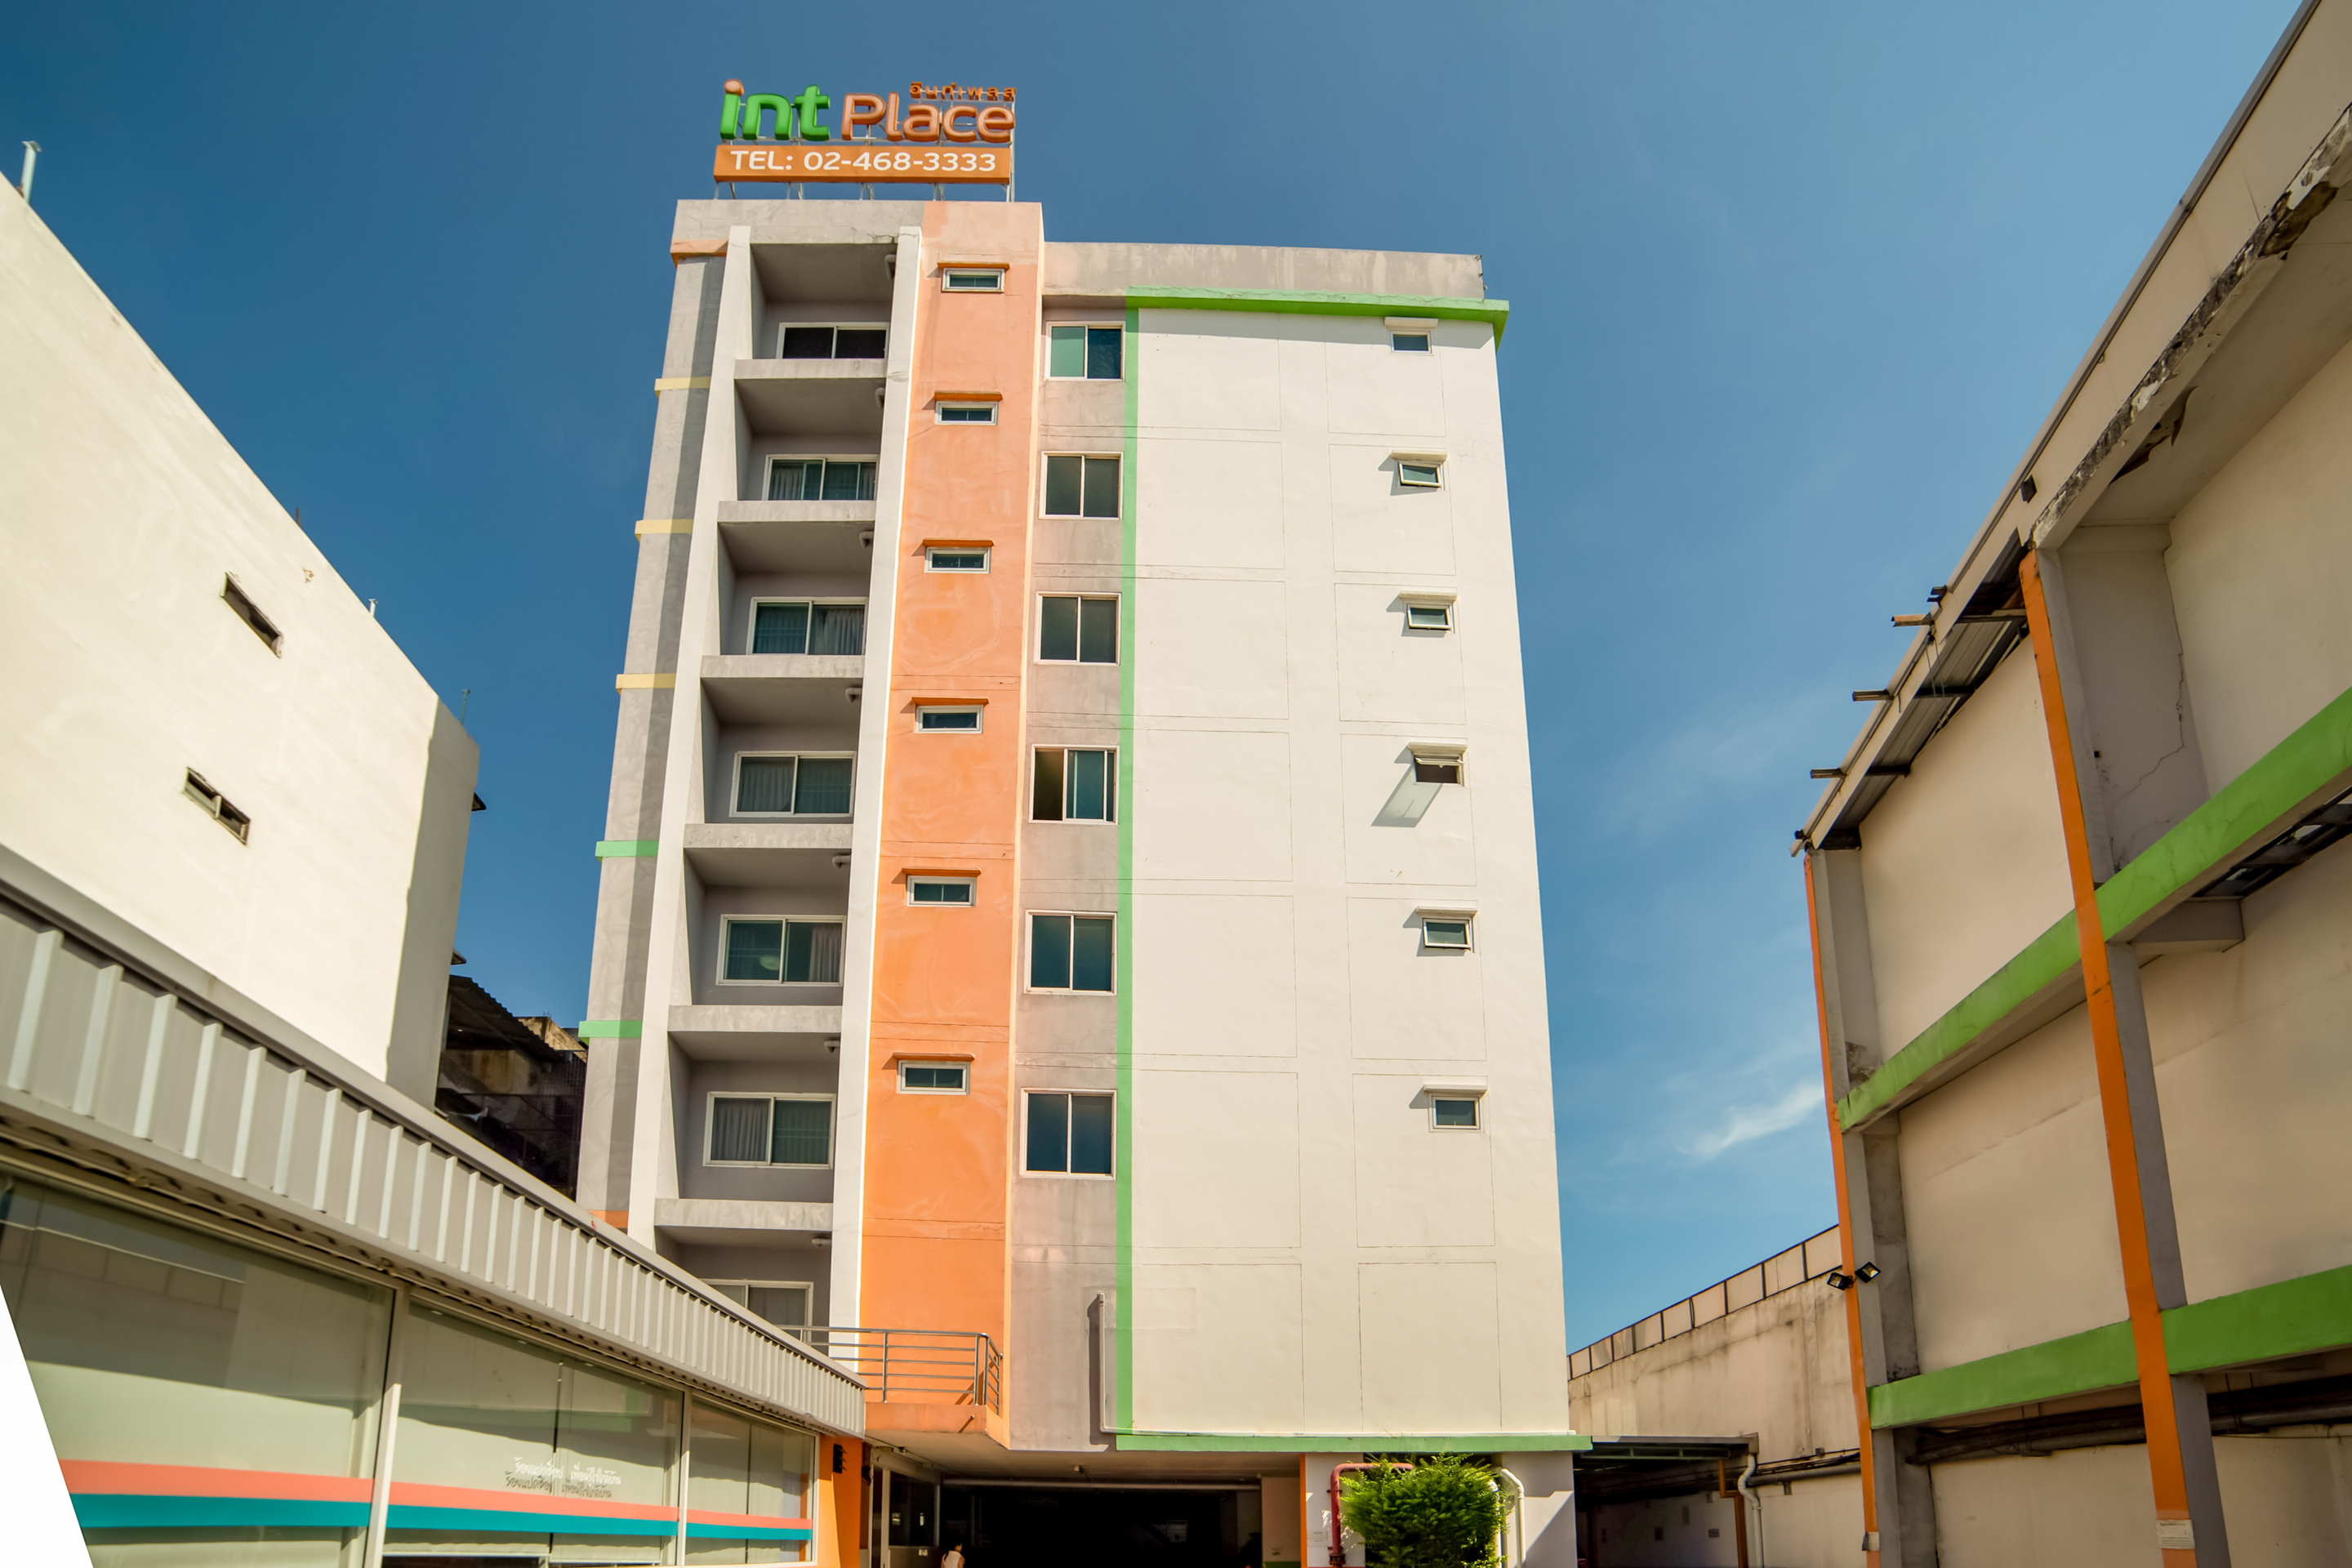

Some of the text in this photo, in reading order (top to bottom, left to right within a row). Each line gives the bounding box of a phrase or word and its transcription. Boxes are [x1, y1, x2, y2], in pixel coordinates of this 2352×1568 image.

[719, 78, 1016, 143] int Place
[730, 150, 996, 172] TEL: 02-468-3333
